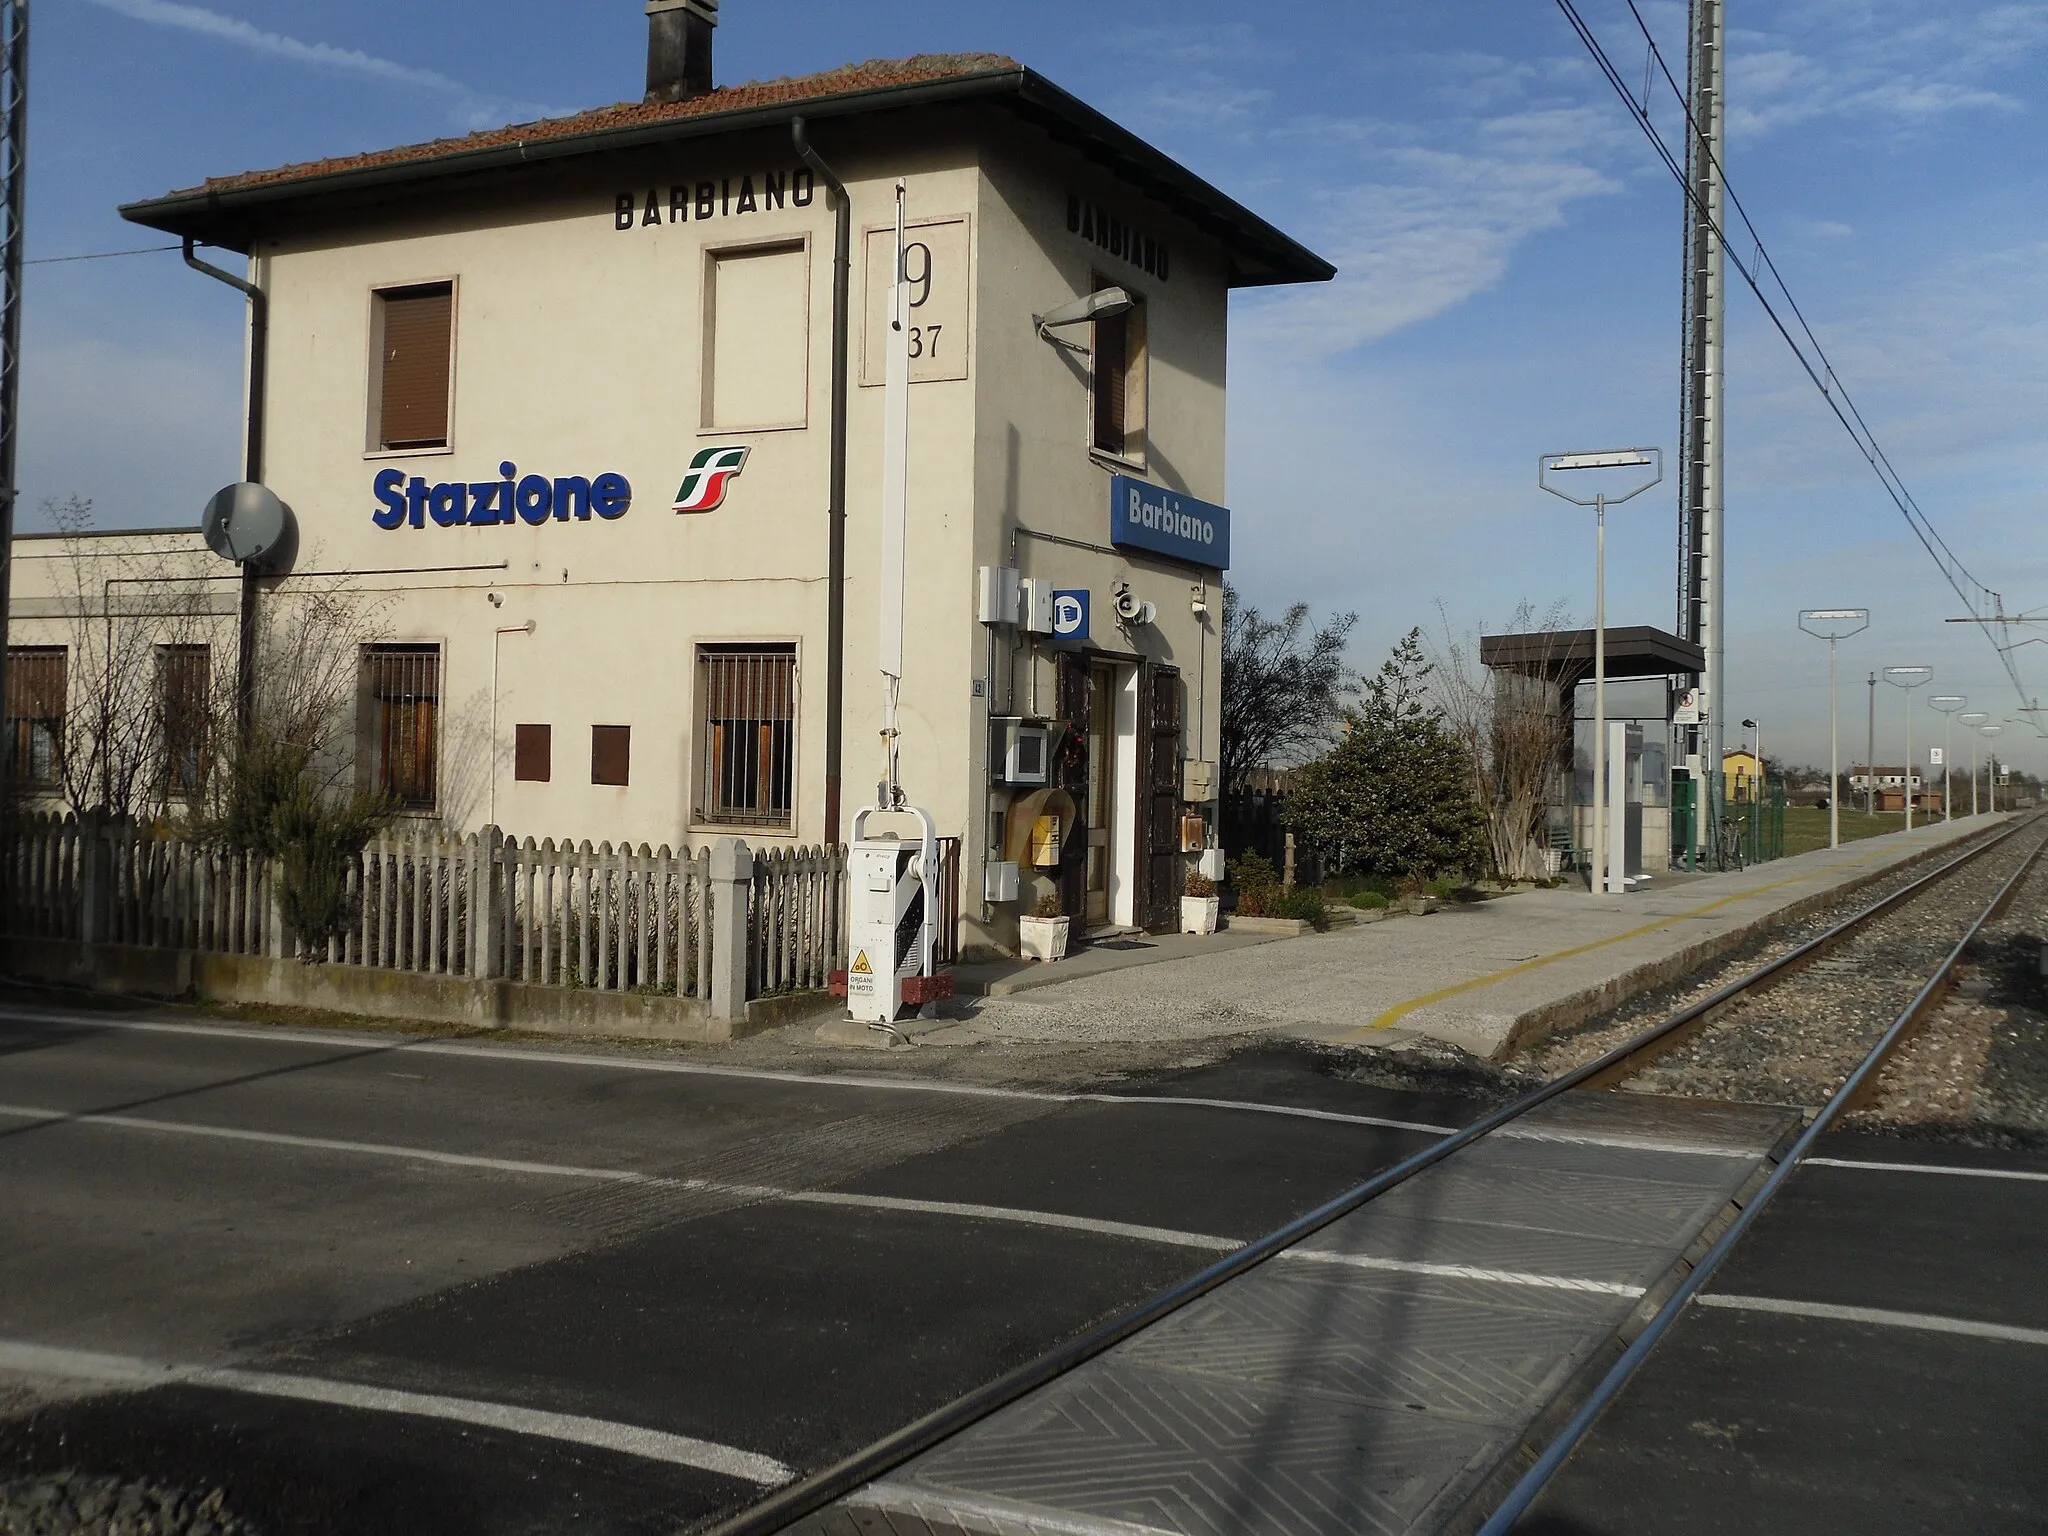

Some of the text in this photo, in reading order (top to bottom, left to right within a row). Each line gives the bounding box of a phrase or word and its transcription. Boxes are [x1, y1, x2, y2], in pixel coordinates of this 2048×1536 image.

[615, 168, 814, 231] BARBIANO
[1066, 192, 1169, 282] BARBIANO
[371, 460, 633, 531] Stazione
[1129, 488, 1214, 545] Barbiano
[850, 976, 873, 984] ORGANI
